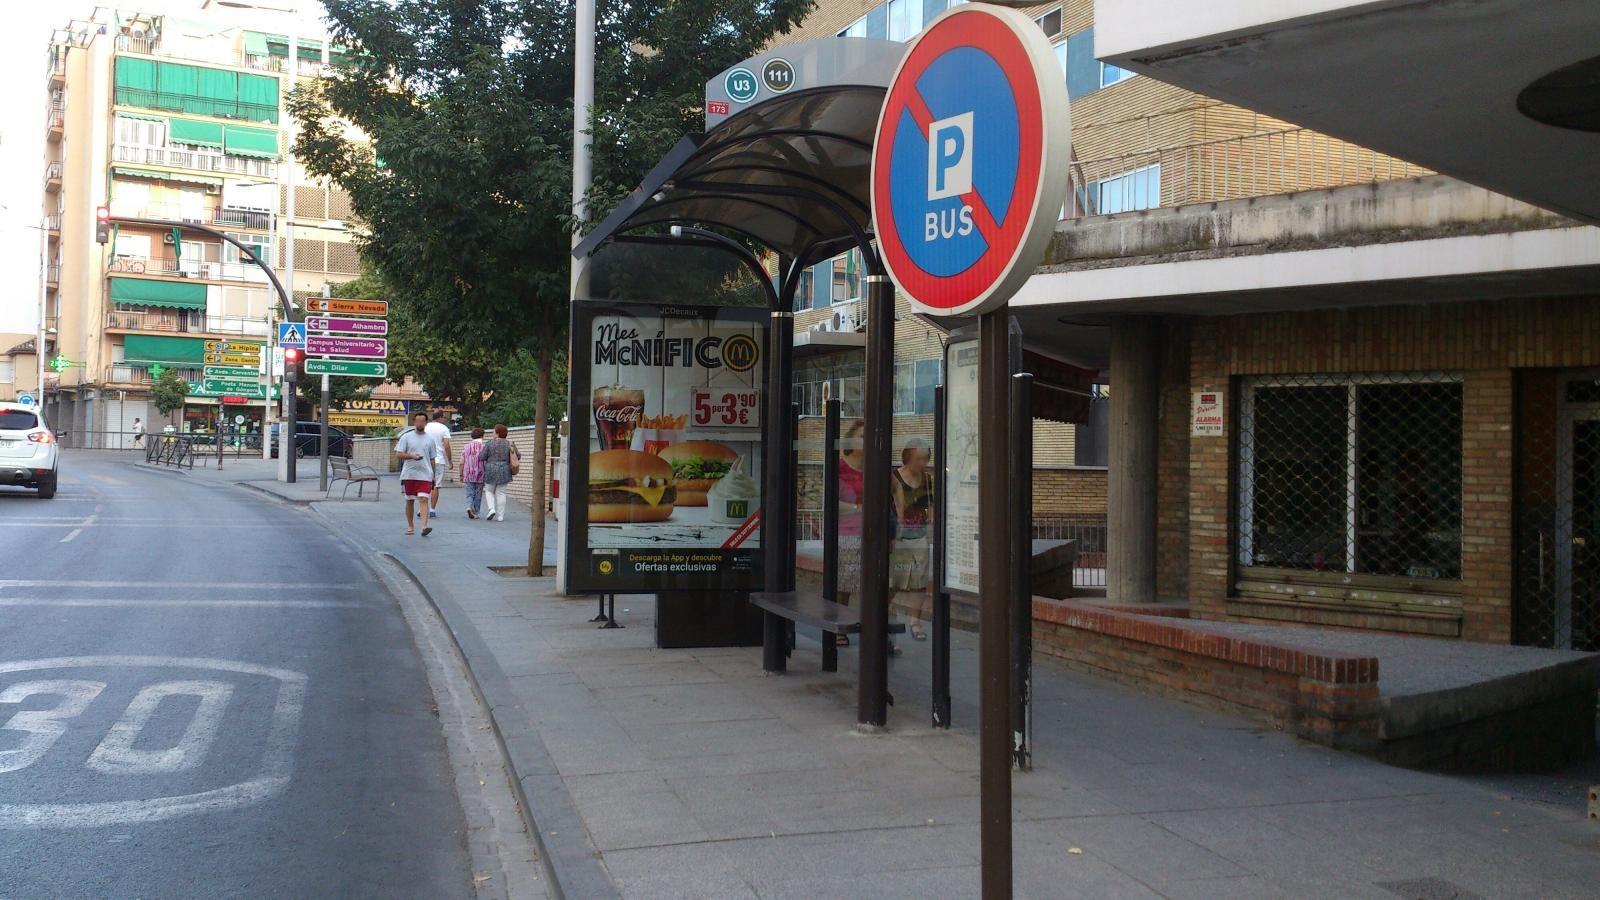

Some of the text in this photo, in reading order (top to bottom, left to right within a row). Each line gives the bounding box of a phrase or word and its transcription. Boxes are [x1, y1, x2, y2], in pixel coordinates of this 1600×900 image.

[769, 70, 788, 82] 111
[733, 80, 751, 91] U3
[711, 105, 726, 113] 173
[936, 125, 964, 192] P
[925, 205, 973, 242] BUS
[660, 307, 698, 316] JCDecaux
[352, 323, 385, 331] Alhambra
[597, 323, 639, 342] Mes
[335, 340, 375, 348] Universitario
[343, 399, 406, 411] TOPEDIA
[695, 393, 711, 425] 5
[596, 404, 642, 423] Coca-Cola
[629, 554, 662, 563] Descarga
[671, 554, 684, 563] App
[635, 562, 717, 572] Ofertas exclusivas
[0, 679, 235, 776] 30
